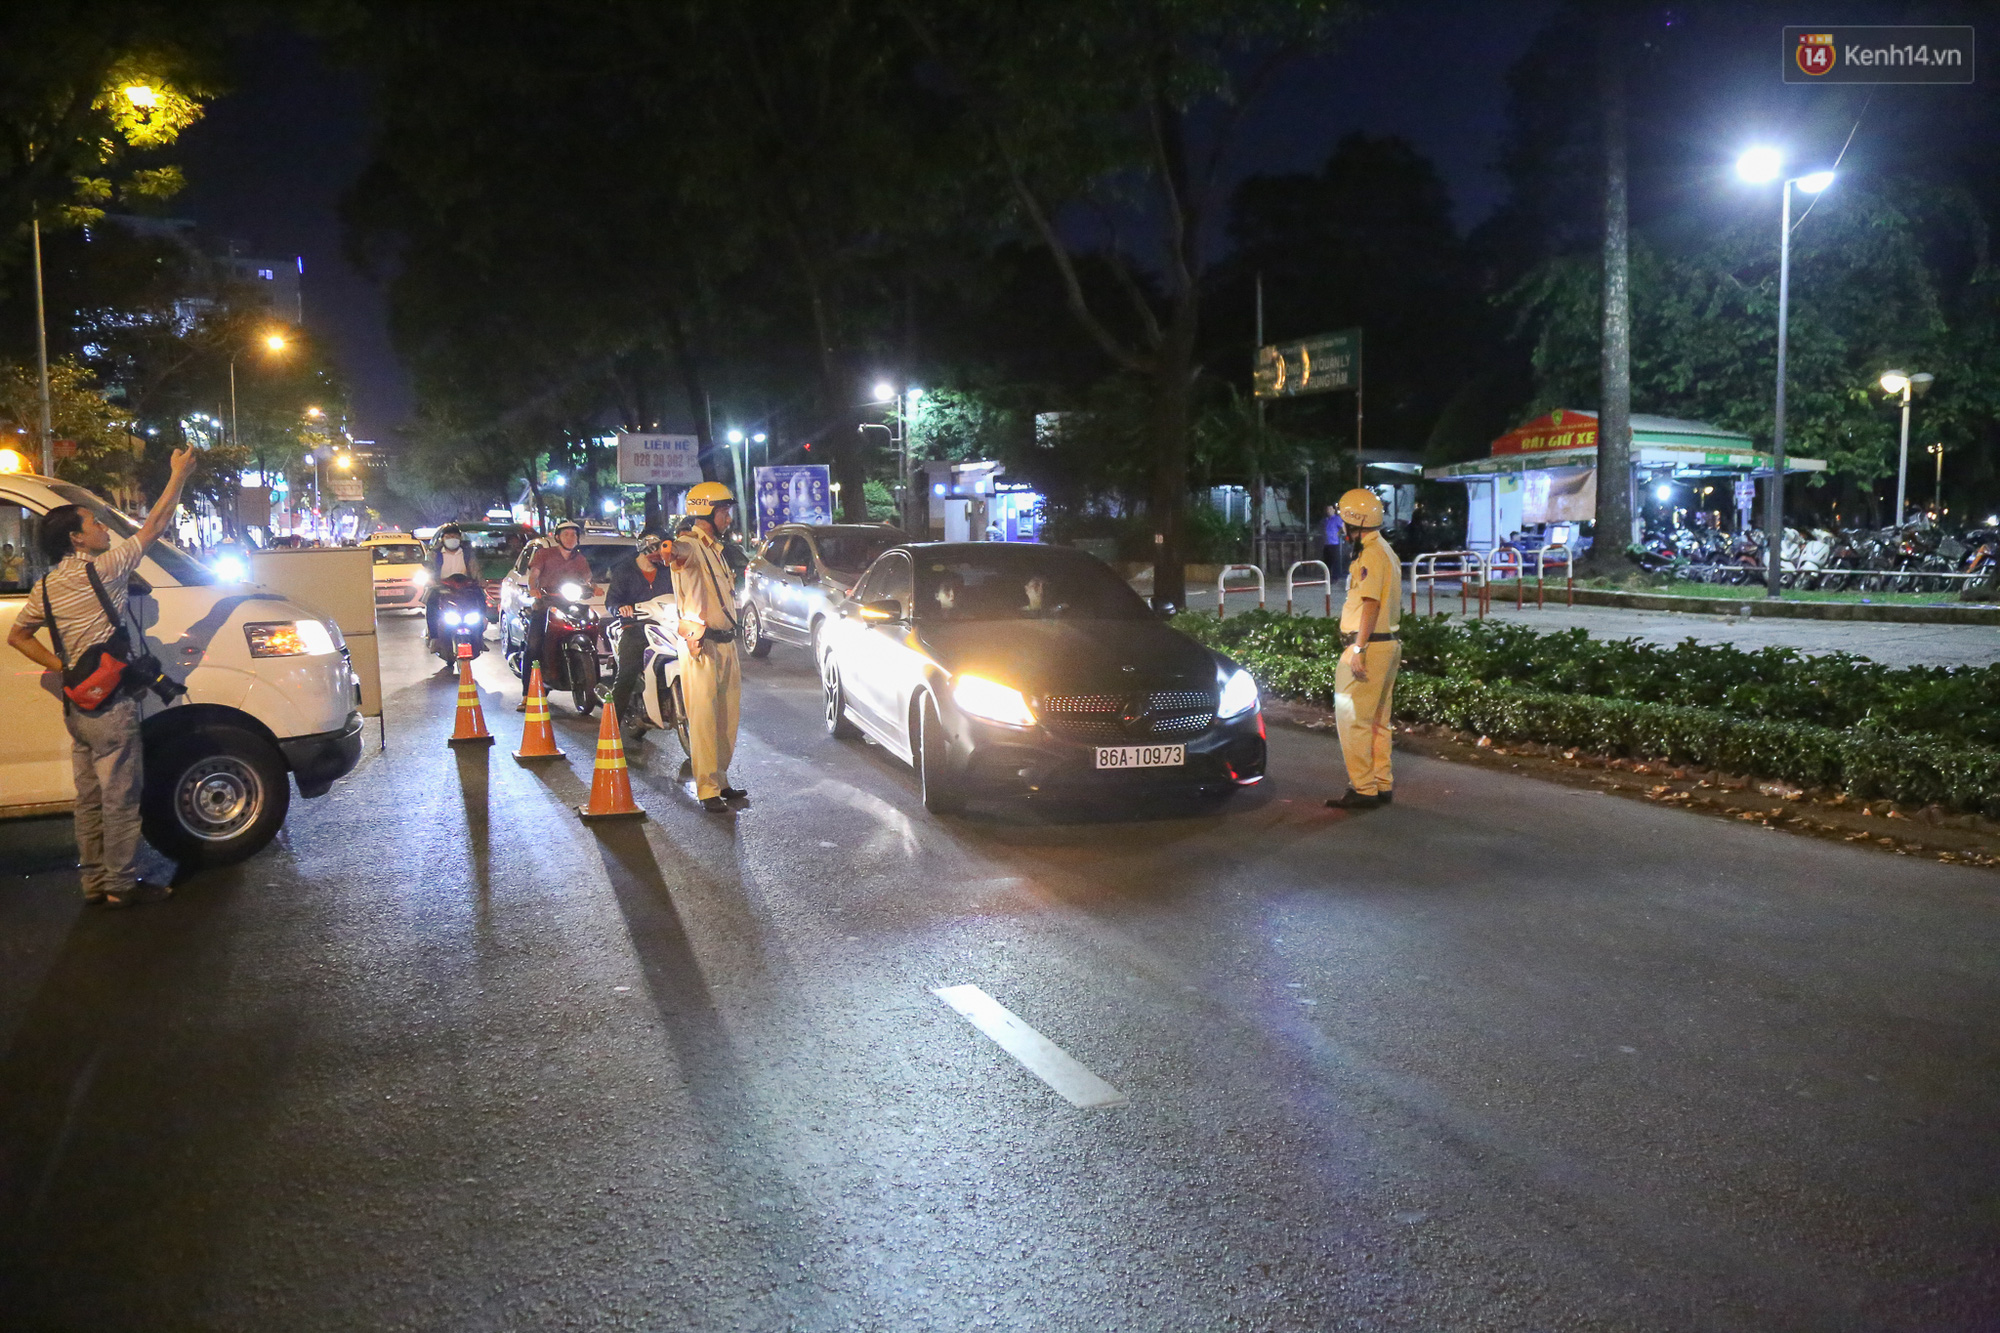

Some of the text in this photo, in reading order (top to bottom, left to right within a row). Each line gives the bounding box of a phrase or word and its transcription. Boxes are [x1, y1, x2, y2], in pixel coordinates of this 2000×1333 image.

[644, 438, 671, 450] LIÊN
[1576, 431, 1597, 445] XE
[1099, 746, 1182, 767] 86A-109.73
